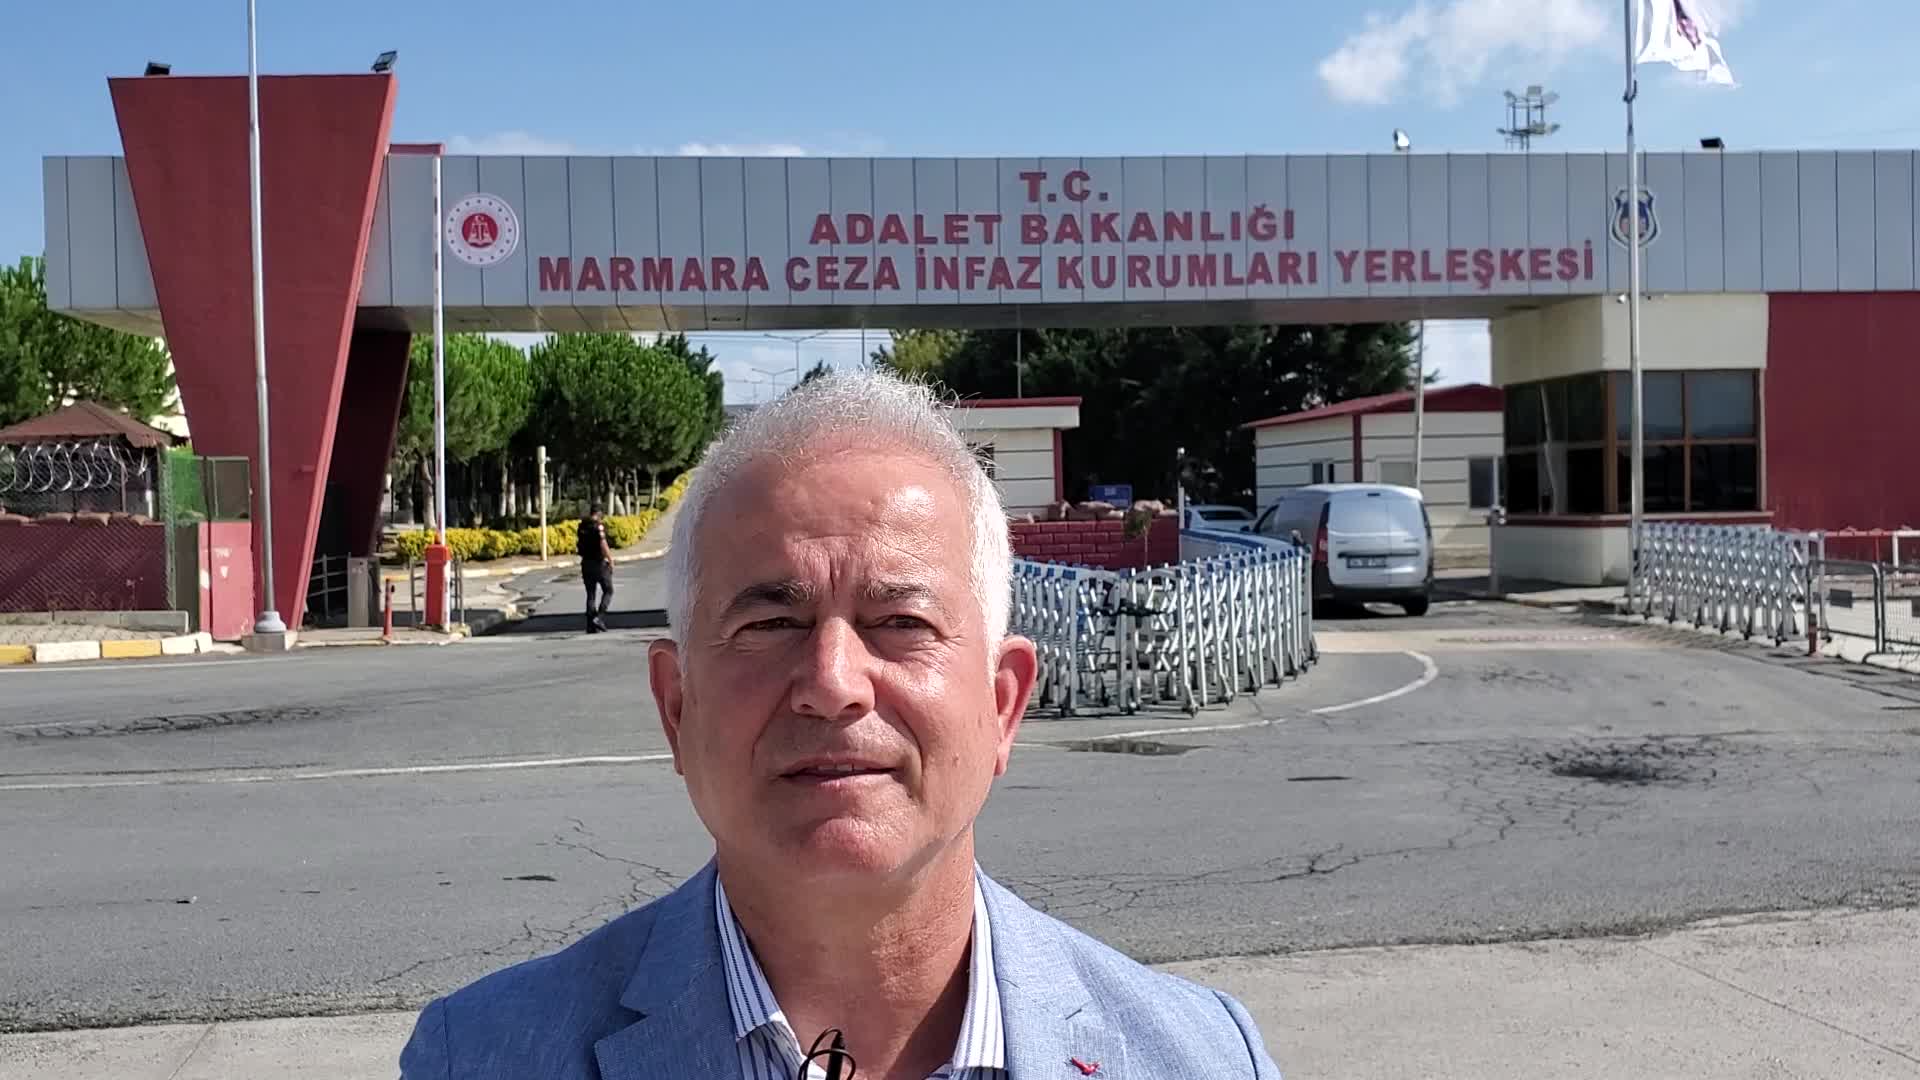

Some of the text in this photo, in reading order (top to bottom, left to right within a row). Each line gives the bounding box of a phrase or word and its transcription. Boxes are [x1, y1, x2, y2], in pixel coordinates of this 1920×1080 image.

[1019, 170, 1109, 203] T.C.
[809, 204, 1295, 246] ADALET BAKANLIĞI
[538, 239, 1594, 292] MARMARA CEZA İNFAZ KURUMLARI YERLEŞKESİ
